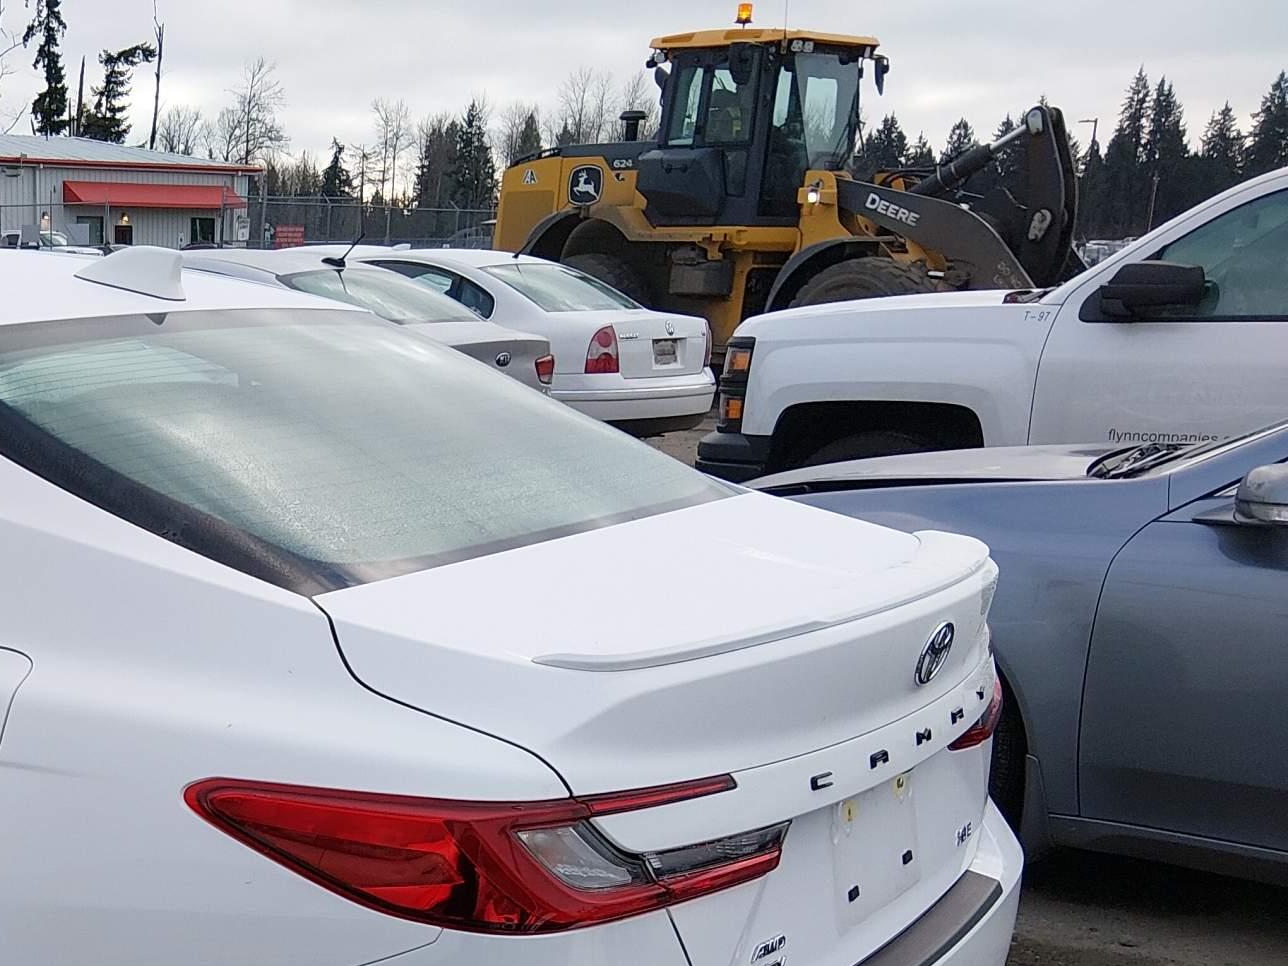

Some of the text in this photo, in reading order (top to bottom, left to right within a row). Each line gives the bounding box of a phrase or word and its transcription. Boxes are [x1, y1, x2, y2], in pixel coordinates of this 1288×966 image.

[613, 159, 632, 168] 624
[865, 192, 921, 227] DEERE
[810, 686, 986, 791] CAMRY
